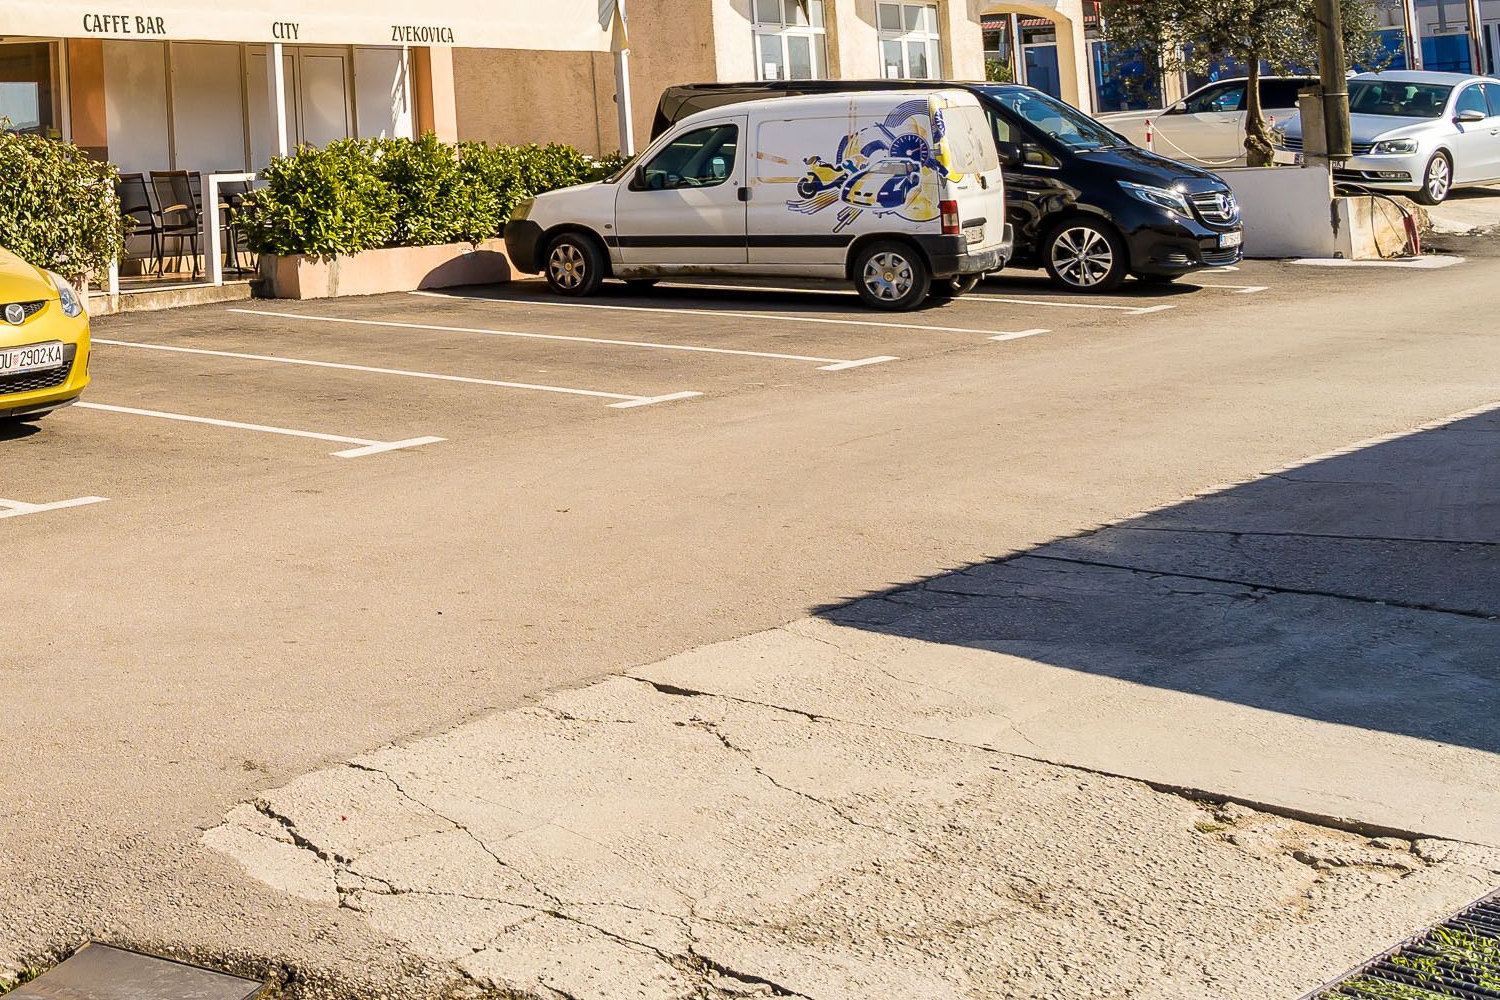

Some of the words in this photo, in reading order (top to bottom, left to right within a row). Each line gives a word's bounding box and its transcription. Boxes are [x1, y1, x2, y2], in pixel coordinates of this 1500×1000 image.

[83, 13, 130, 34] CAFFE
[135, 15, 166, 35] BAR
[272, 21, 300, 40] CITY
[391, 25, 455, 43] ZVEKOVICA
[19, 346, 61, 367] 2902-KA
